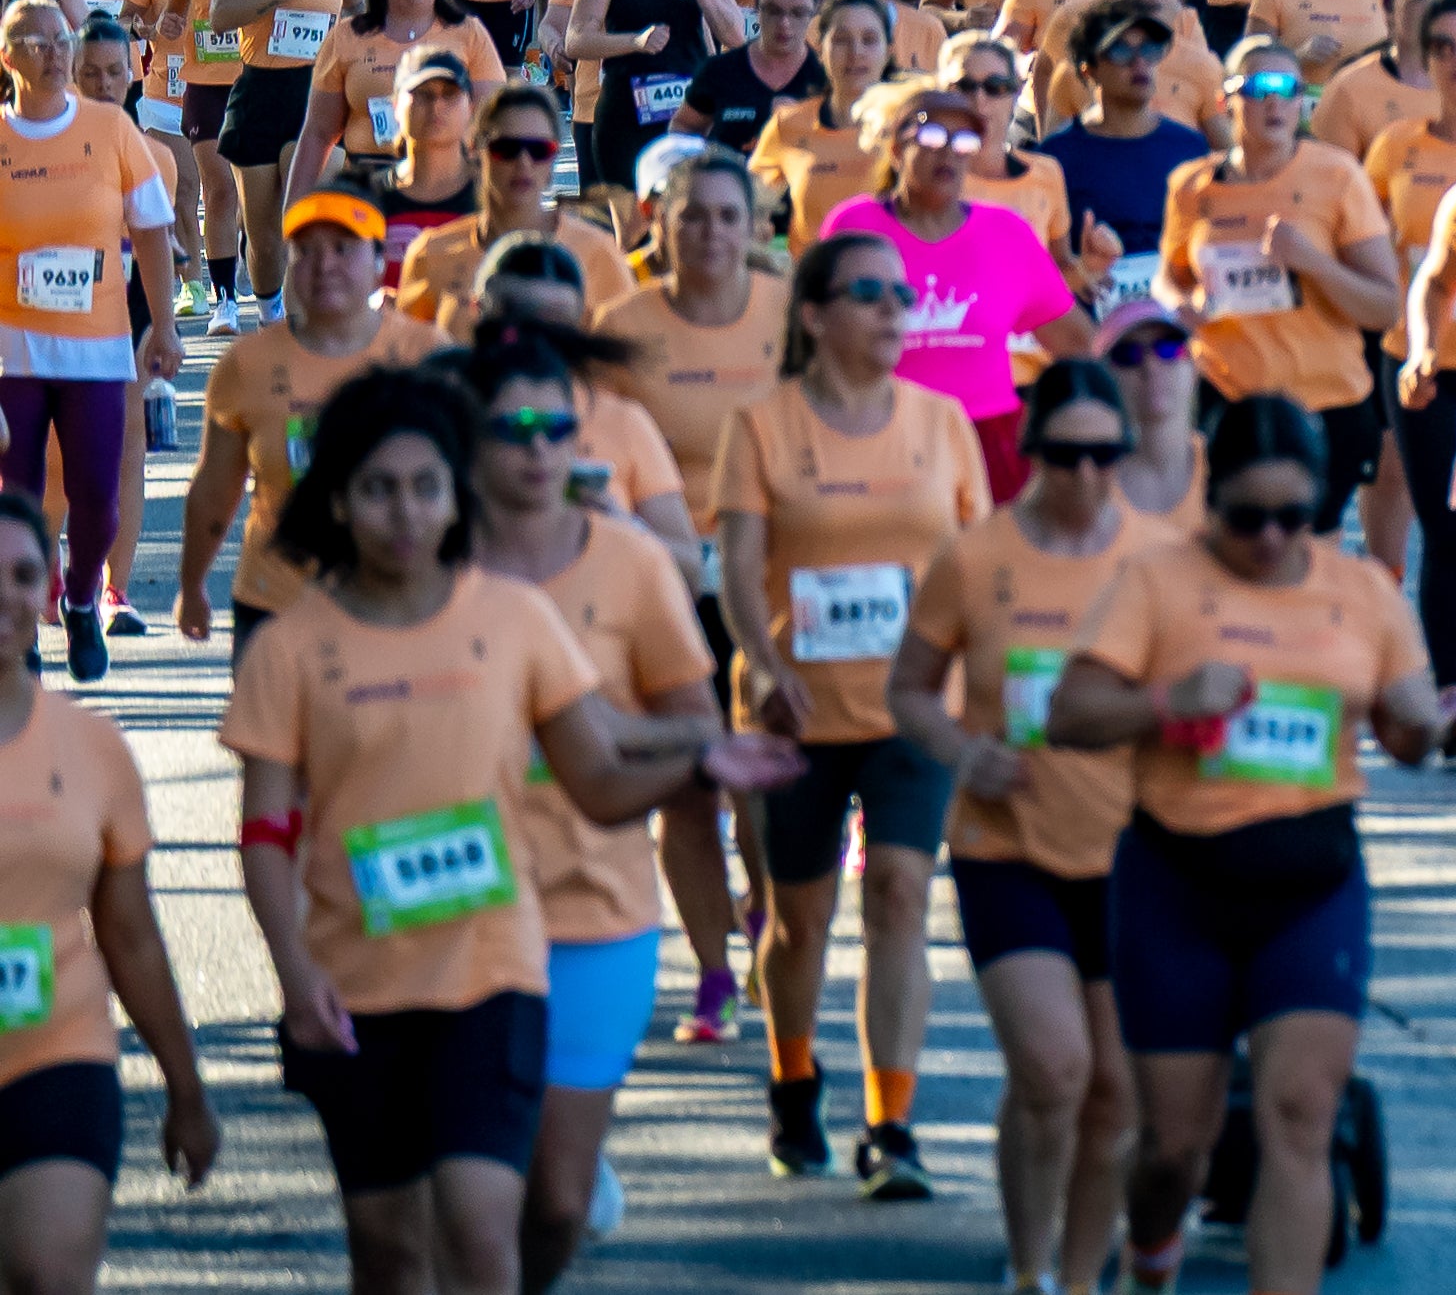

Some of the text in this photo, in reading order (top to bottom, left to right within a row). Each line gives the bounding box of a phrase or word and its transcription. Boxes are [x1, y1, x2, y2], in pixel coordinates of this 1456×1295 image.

[211, 32, 238, 45] 5751
[293, 27, 323, 42] 9751
[654, 84, 687, 101] 440
[43, 269, 90, 287] 9639
